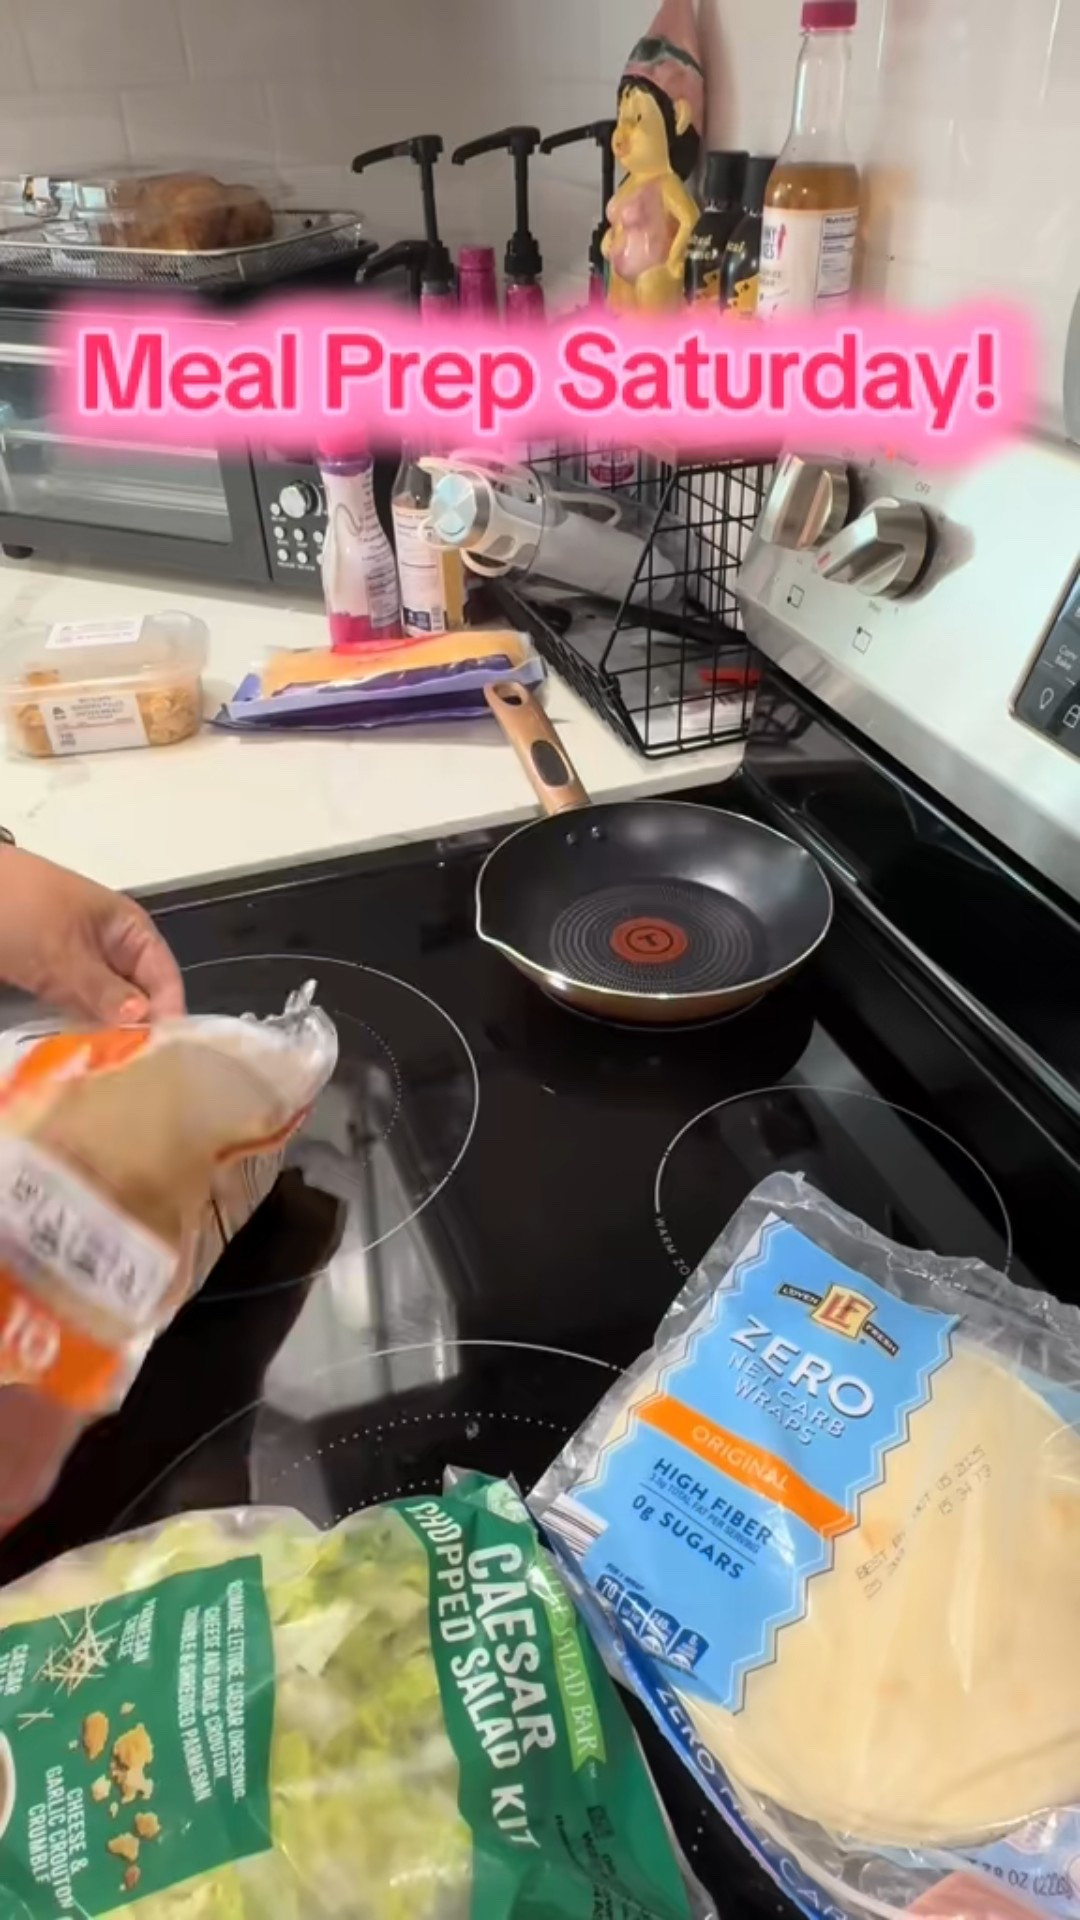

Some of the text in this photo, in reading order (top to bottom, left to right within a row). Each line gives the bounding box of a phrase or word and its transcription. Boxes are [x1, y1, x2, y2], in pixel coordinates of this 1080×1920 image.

[655, 1217, 677, 1255] WARM
[727, 1350, 847, 1439] NET CARB
[729, 1313, 875, 1420] ZERO
[734, 1376, 817, 1446] WRAPS
[653, 1457, 773, 1545] HIGH FIBER
[691, 1424, 790, 1492] ORIGINAL
[632, 1494, 745, 1580] 0g SUGARS
[601, 1577, 619, 1600] 70
[3, 1643, 30, 1697] CAESAR
[404, 1501, 542, 1849] CHOPPED SALAD KIT
[467, 1541, 557, 1756] CAESAR
[553, 1626, 587, 1698] SALAD
[570, 1704, 598, 1756] BAR
[178, 1662, 197, 1729] SHREDDED
[202, 1605, 228, 1779] CHEESE AND GARLIC CROUTON
[226, 1681, 245, 1728] CAESAR
[180, 1728, 213, 1804] PARMESAN
[27, 1802, 51, 1884] CRUMBLE
[45, 1764, 75, 1910] GARLIC CROUTON
[66, 1786, 89, 1876] CHEESE &
